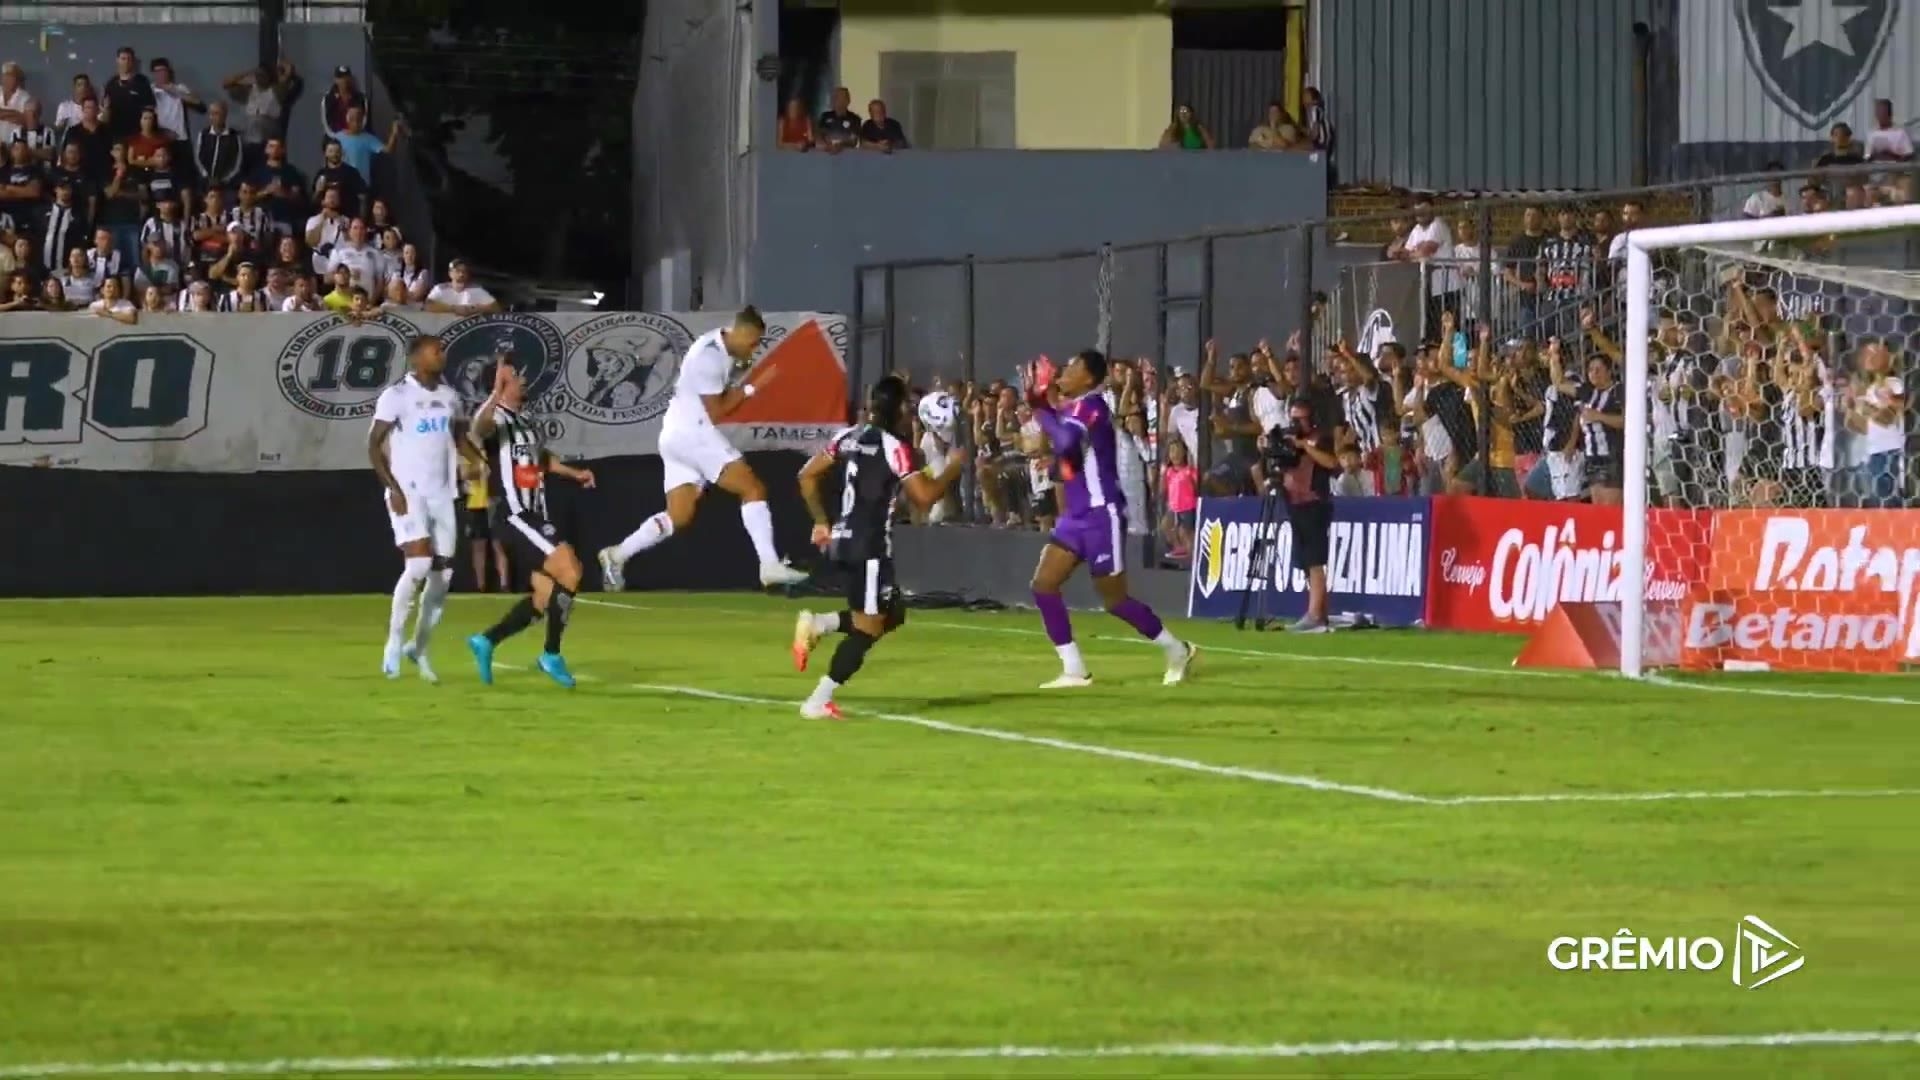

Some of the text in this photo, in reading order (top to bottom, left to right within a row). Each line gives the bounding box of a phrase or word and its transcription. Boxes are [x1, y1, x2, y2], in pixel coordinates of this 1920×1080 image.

[308, 335, 396, 392] 18
[841, 459, 858, 518] 6
[1365, 522, 1422, 596] LIMA
[1440, 547, 1486, 597] Cerveja
[1685, 602, 1899, 650] Betano
